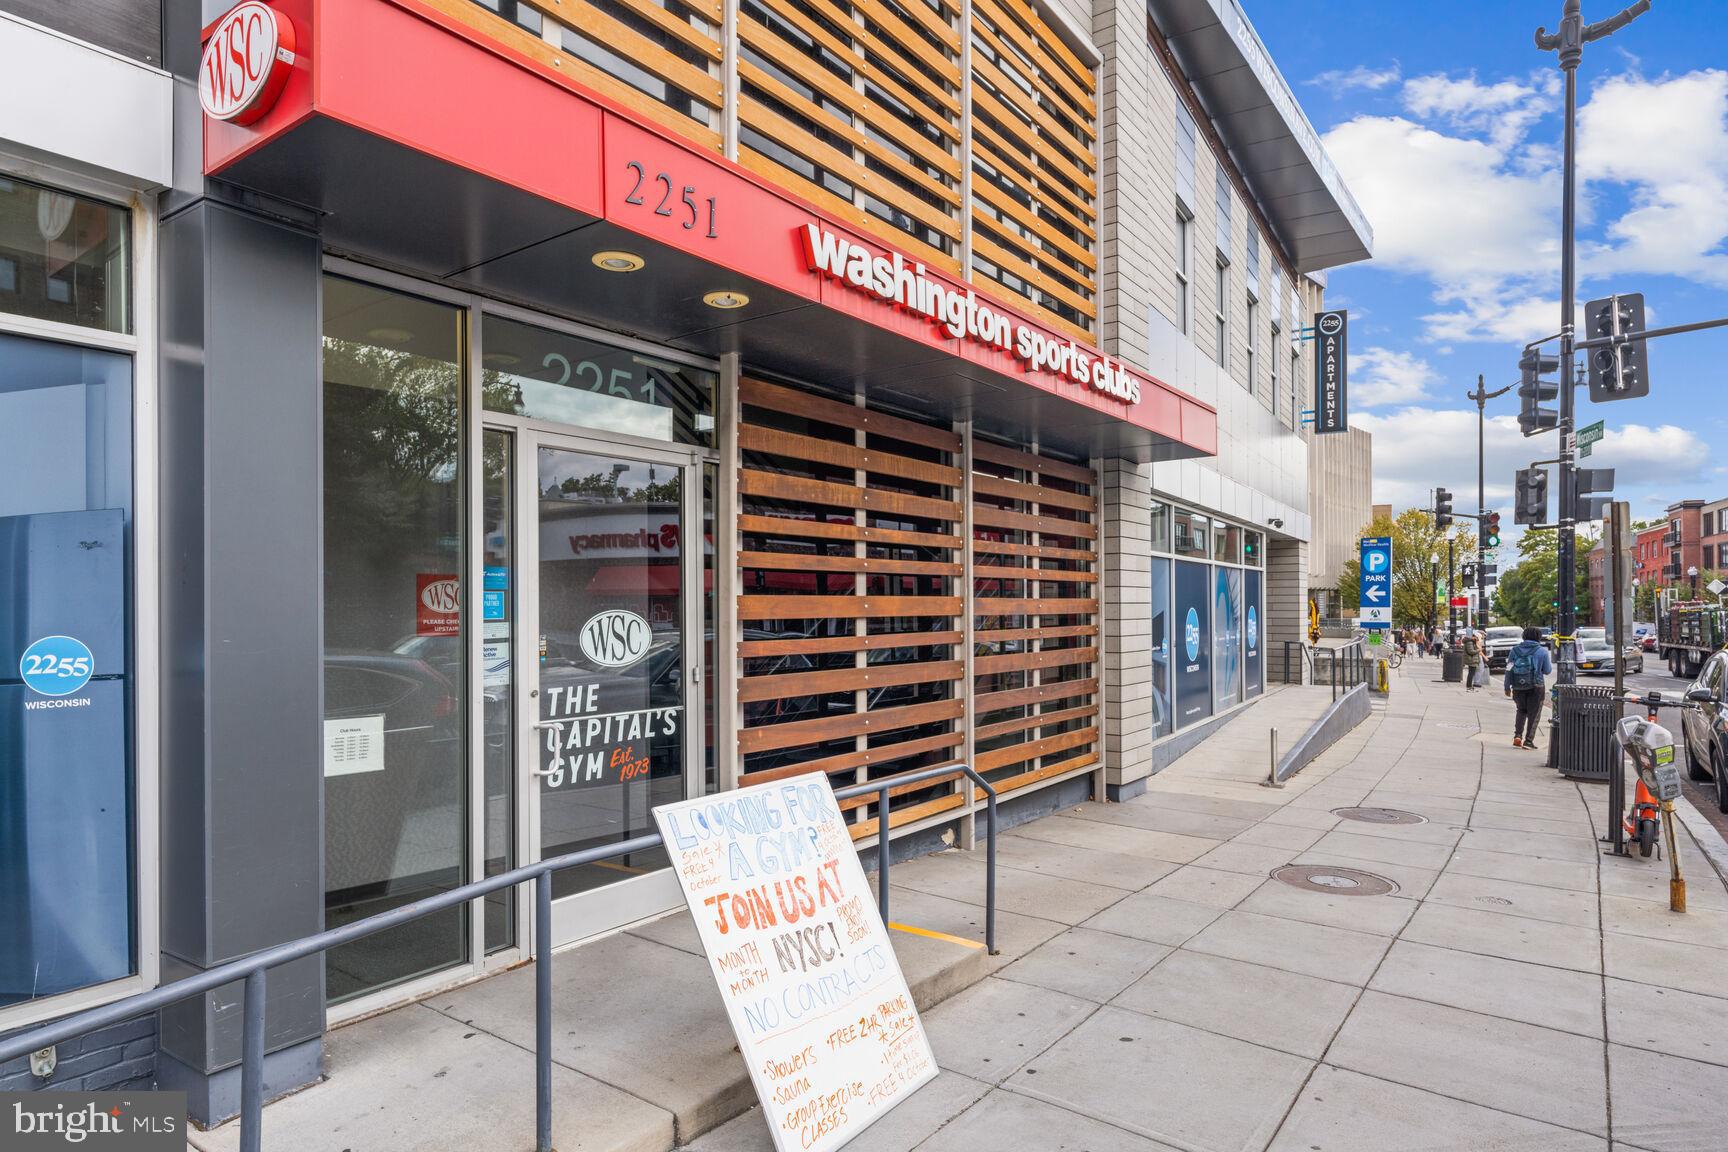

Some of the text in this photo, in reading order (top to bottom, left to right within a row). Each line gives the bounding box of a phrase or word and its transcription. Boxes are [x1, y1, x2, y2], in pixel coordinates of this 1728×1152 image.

[207, 13, 263, 109] WSC
[625, 160, 718, 238] 2251
[804, 223, 1141, 405] washington sports clubs
[1326, 336, 1336, 428] APARTMENTS
[1369, 553, 1385, 572] P
[589, 614, 643, 661] WSC
[25, 654, 89, 678] 2255
[25, 698, 91, 710] WISCONSIN
[547, 684, 600, 716] THE
[546, 709, 677, 752] CAPITAL'S
[547, 751, 605, 788] GYM
[609, 746, 635, 769] Est.
[619, 757, 650, 782] 1973
[667, 783, 836, 850] LOOKING FOR
[728, 842, 755, 881] A
[756, 825, 822, 874] GYM?
[703, 858, 846, 935] JOIN US AT
[717, 939, 763, 974] MONTH
[771, 921, 845, 974] NYSC!
[730, 967, 770, 997] MONTH
[743, 945, 887, 1034] NO CONTRACTS
[829, 1024, 856, 1052] FREE
[766, 1045, 817, 1080] Showers
[776, 1077, 811, 1105] Sauna
[801, 1107, 849, 1150] CLASSES
